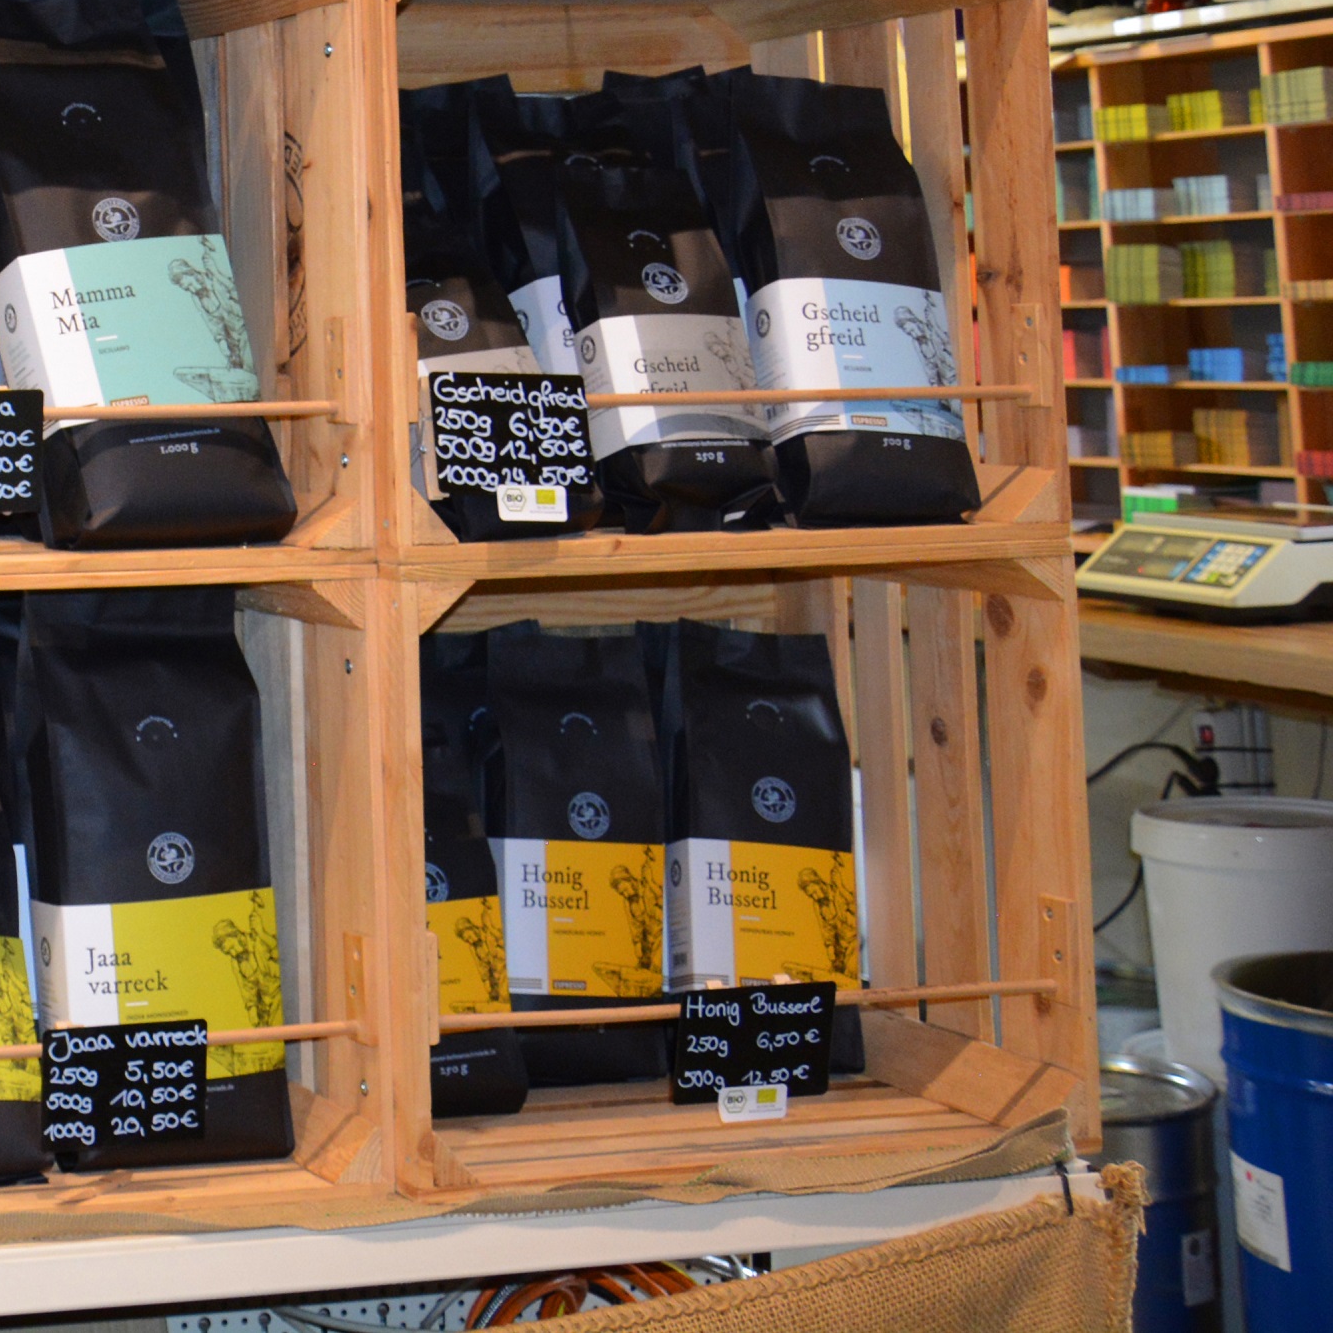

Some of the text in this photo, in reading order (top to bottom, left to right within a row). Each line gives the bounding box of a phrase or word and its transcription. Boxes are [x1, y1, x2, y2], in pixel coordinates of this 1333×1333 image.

[51, 285, 136, 310] Mamma
[57, 313, 101, 335] Mia
[802, 303, 881, 323] Gscheid
[807, 327, 867, 352] gfreid
[634, 357, 700, 375] Gscheid
[433, 371, 588, 425] Gscheid gfreid
[435, 407, 492, 435] 250g
[522, 864, 583, 888] Honig
[706, 862, 770, 890] Honig
[522, 888, 591, 910] Busserl
[707, 886, 777, 910] Busserl
[85, 947, 133, 975] Jaaa
[88, 970, 169, 995] varreck
[686, 992, 823, 1026] Honig Busserl
[47, 1024, 207, 1062] Jaaa varreck
[687, 1035, 728, 1058] 250g
[49, 1059, 194, 1088] 250g 5,50€
